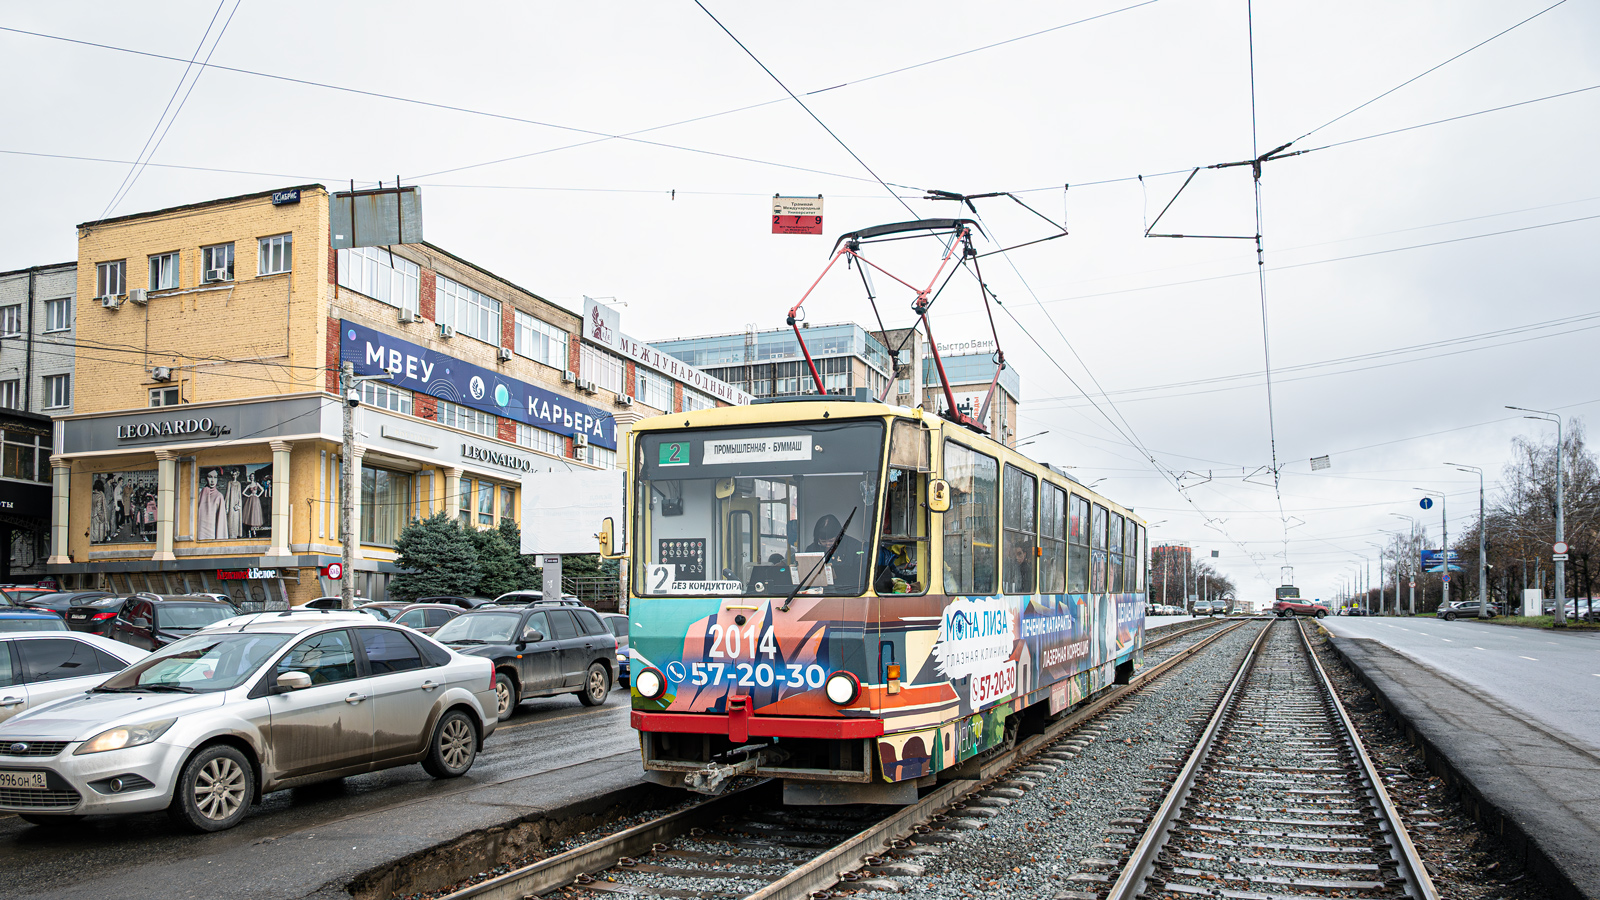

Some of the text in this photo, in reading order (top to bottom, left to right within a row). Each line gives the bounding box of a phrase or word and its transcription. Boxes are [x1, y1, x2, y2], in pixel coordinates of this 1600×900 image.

[773, 215, 822, 225] 2 7 9
[365, 340, 435, 384] МВЕУ
[619, 336, 734, 401] МЕЖДУНАРОДНЫЙ
[116, 417, 214, 440] LEONARDO
[528, 395, 604, 438] КАРЬЕРА
[461, 443, 532, 472] LEONARDO
[669, 443, 681, 462] 2
[713, 442, 767, 455] ПРОМЫШЛЕННАЯ
[773, 440, 803, 453] БУММАШ
[653, 566, 669, 594] 2
[671, 581, 743, 592] БЕЗ КОНДУКТОРА
[946, 609, 1008, 642] МОНА ЛИЗА
[1021, 614, 1072, 638] ЛЕЧЕНИЕ КАТАРАКТЫ
[708, 623, 777, 660] 2014
[1042, 639, 1089, 669] ЛАЗЕРНАЯ КОРРЕКЦИЯ
[946, 644, 1009, 668] ГЛАЗНАЯ КЛИНИКА
[691, 662, 826, 689] 57-20-30
[979, 666, 1016, 702] 57-20-30
[32, 774, 42, 784] 18
